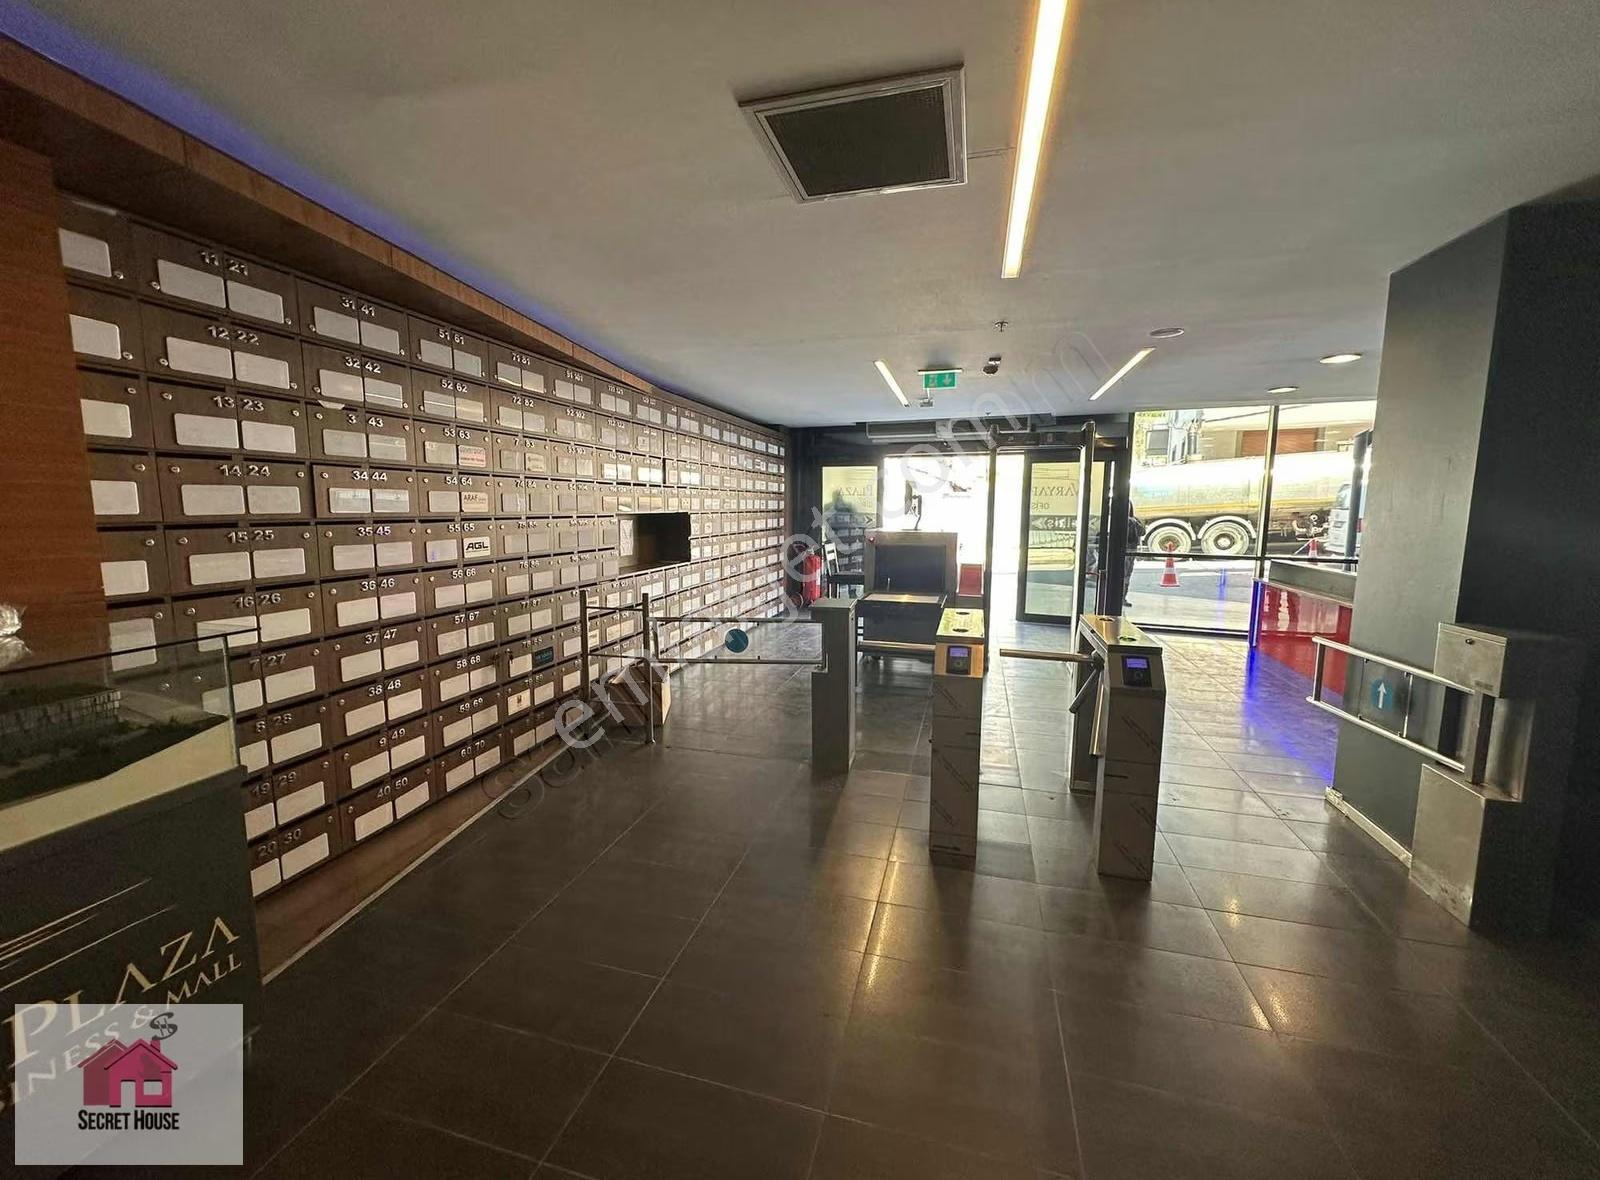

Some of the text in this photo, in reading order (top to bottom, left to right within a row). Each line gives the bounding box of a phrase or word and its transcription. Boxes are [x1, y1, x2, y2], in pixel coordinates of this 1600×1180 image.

[201, 251, 248, 276] 11 21
[341, 296, 375, 316] 31 41
[208, 324, 259, 346] 12 22
[438, 328, 465, 345] 51 61
[345, 357, 381, 374] 32 42
[441, 379, 468, 393] 52 62
[213, 395, 264, 412] 13 23
[368, 416, 384, 428] 43
[444, 428, 471, 440] 53 63
[219, 464, 270, 477] 14 24
[352, 470, 388, 482] 34 44
[445, 476, 473, 486] 54 64
[357, 526, 391, 537] 35 45
[448, 523, 475, 532] 55 65
[227, 529, 274, 544] 15 25
[465, 541, 489, 551] AGL
[361, 578, 395, 591] 36 46
[235, 593, 281, 609] 16 26
[454, 611, 480, 624] 57 67
[365, 628, 397, 644] 37 47
[267, 653, 286, 667] 27
[456, 655, 481, 670] 58 68
[368, 679, 401, 697] 38 48
[391, 728, 406, 741] 49
[474, 739, 485, 751] 70
[252, 771, 297, 797] 19 29
[377, 777, 408, 799] 40 50
[284, 828, 301, 844] 30
[166, 952, 242, 1011] MALL
[2, 916, 240, 1068] PLAZA
